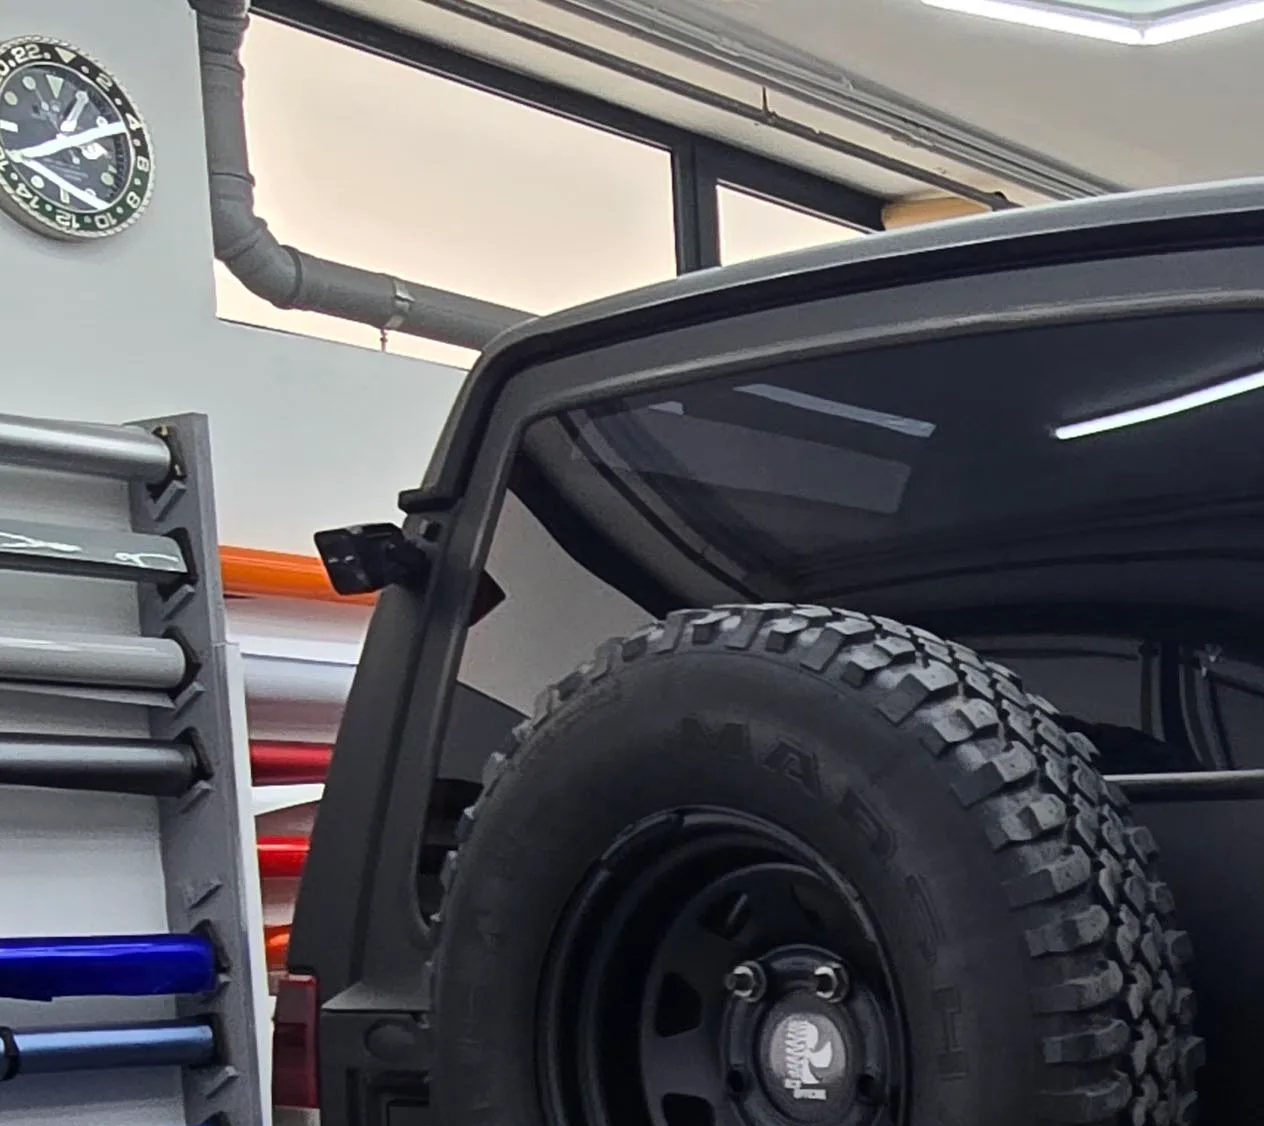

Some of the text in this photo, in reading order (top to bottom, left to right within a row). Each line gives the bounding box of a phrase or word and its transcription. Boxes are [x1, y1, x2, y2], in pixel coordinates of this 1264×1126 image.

[11, 43, 41, 64] 22
[96, 72, 113, 92] 2
[125, 112, 142, 131] 4
[15, 182, 41, 210] 14
[126, 191, 141, 209] 8
[55, 209, 81, 229] 12
[94, 213, 118, 230] 10
